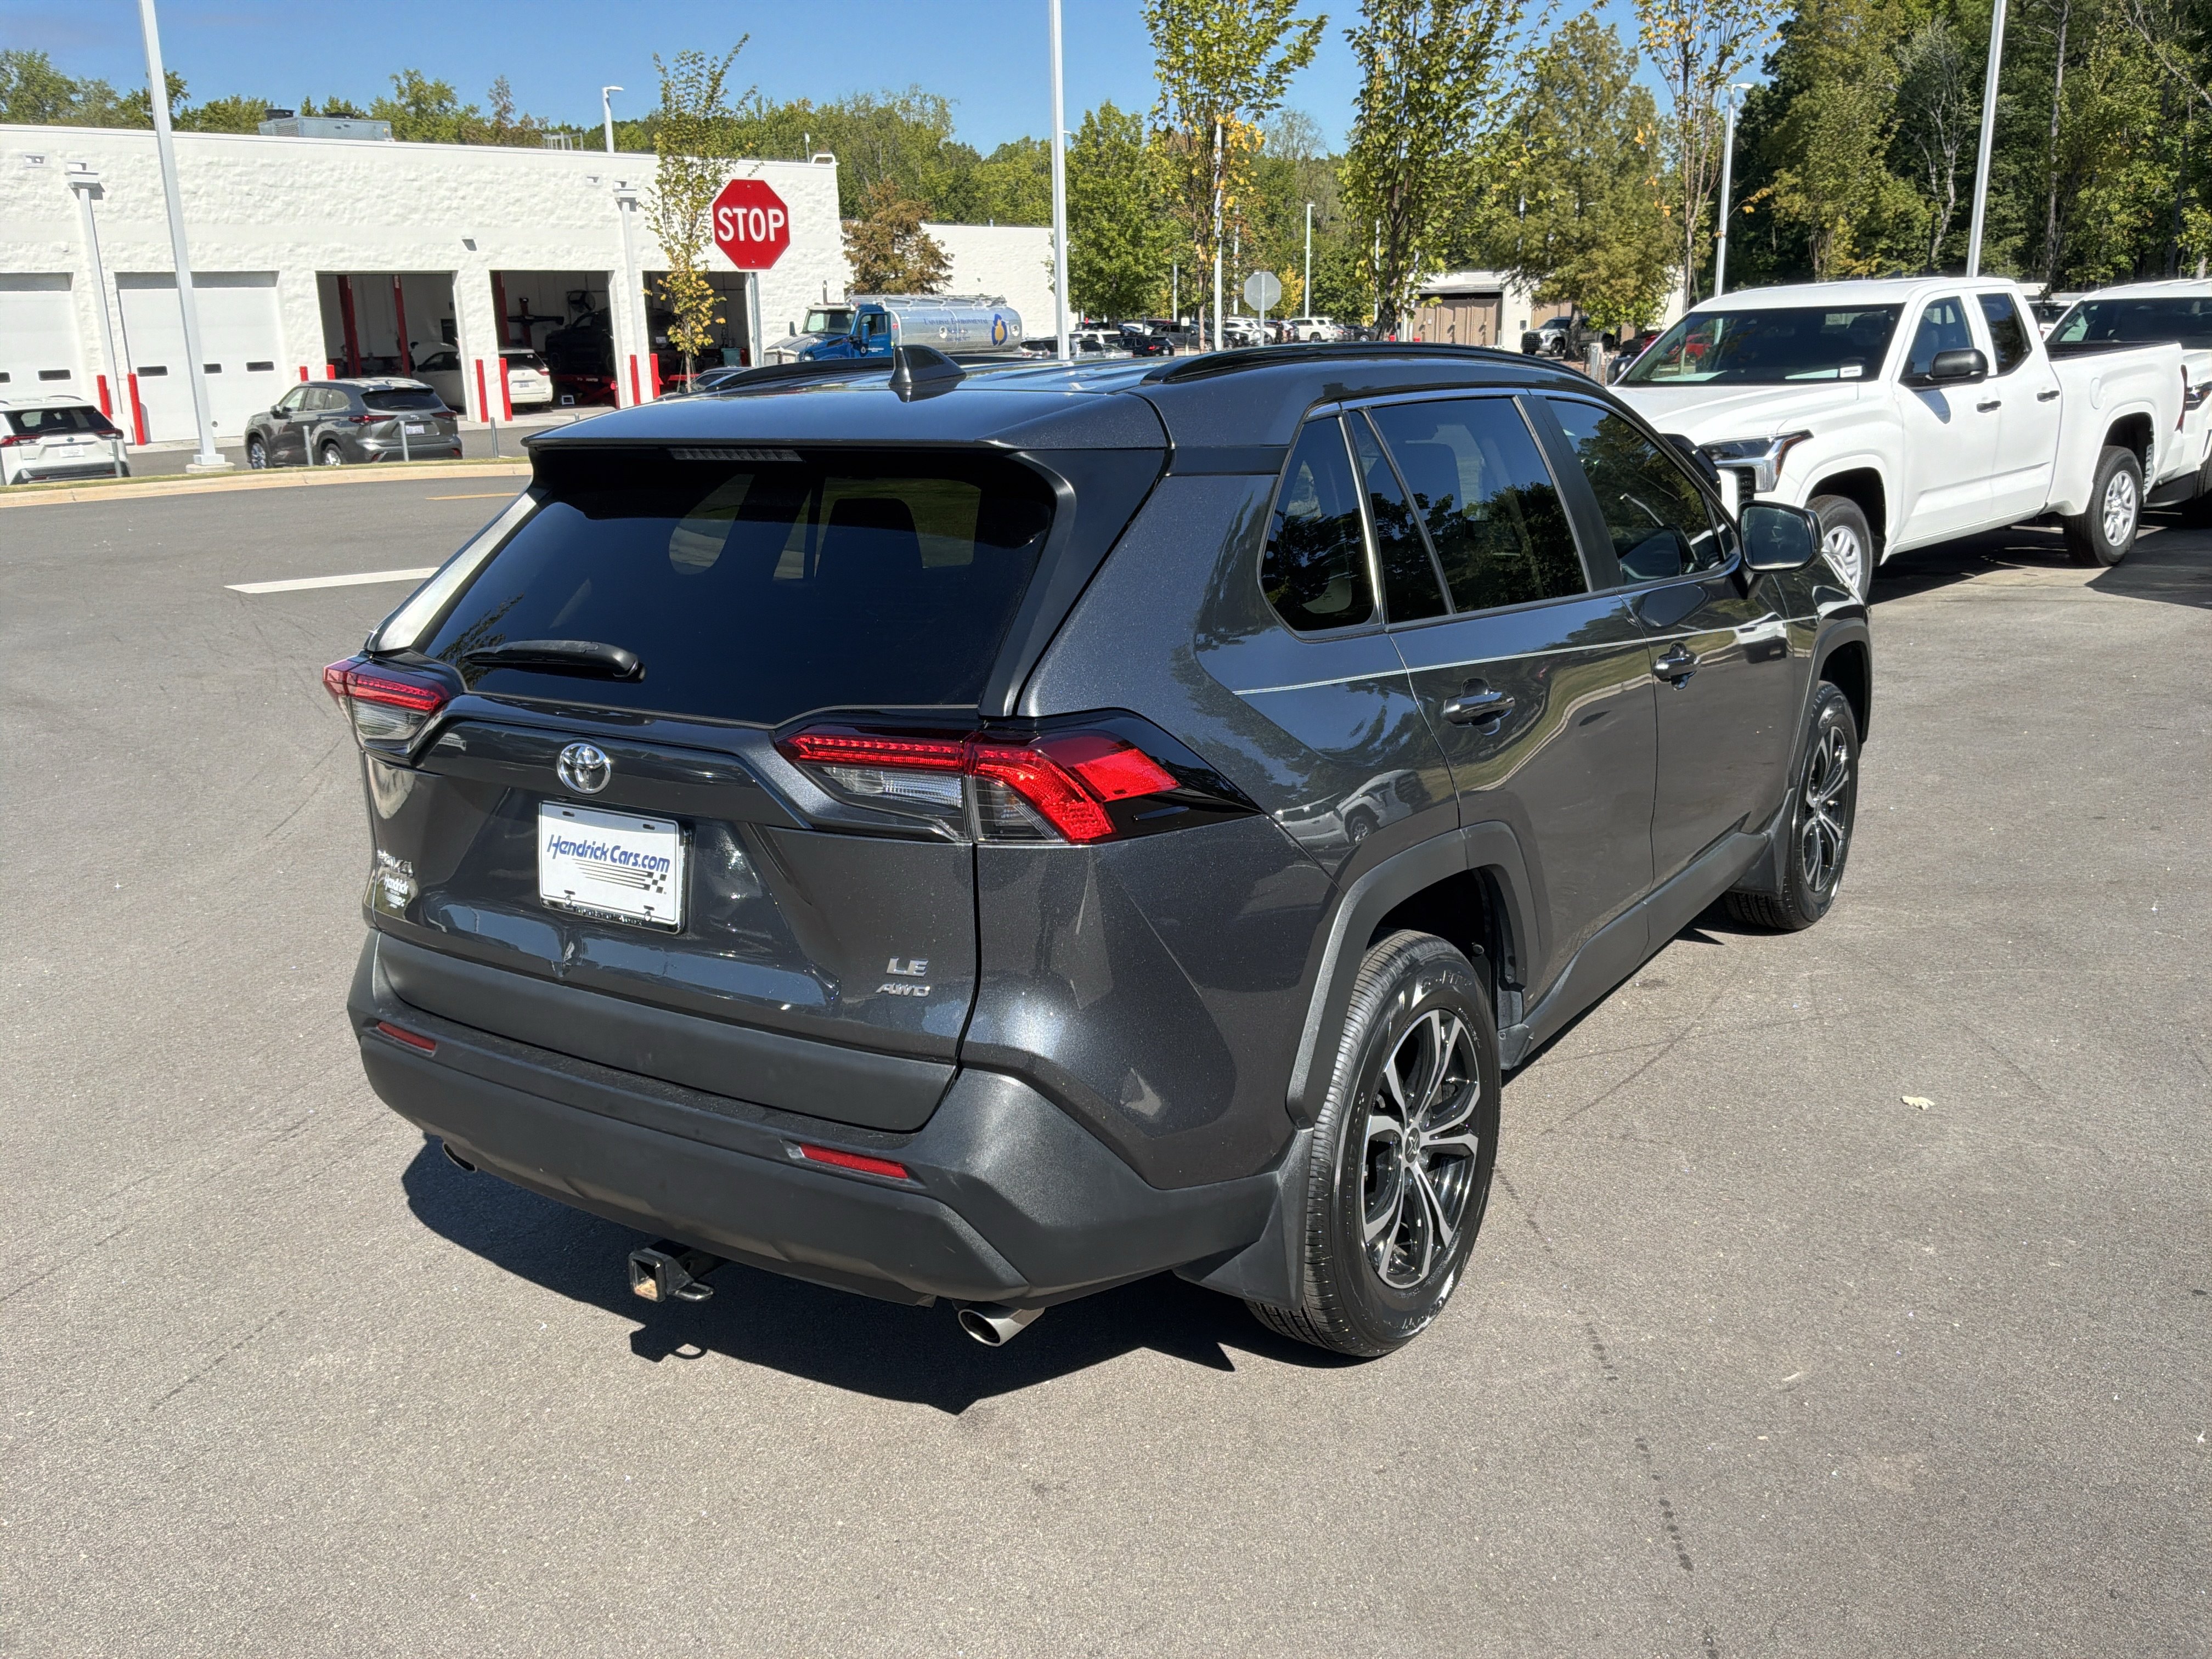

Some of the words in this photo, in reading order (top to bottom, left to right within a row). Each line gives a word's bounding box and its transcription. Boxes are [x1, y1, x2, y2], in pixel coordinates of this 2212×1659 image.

[718, 207, 785, 242] STOP
[886, 956, 929, 977] LE
[875, 983, 931, 997] AWD
